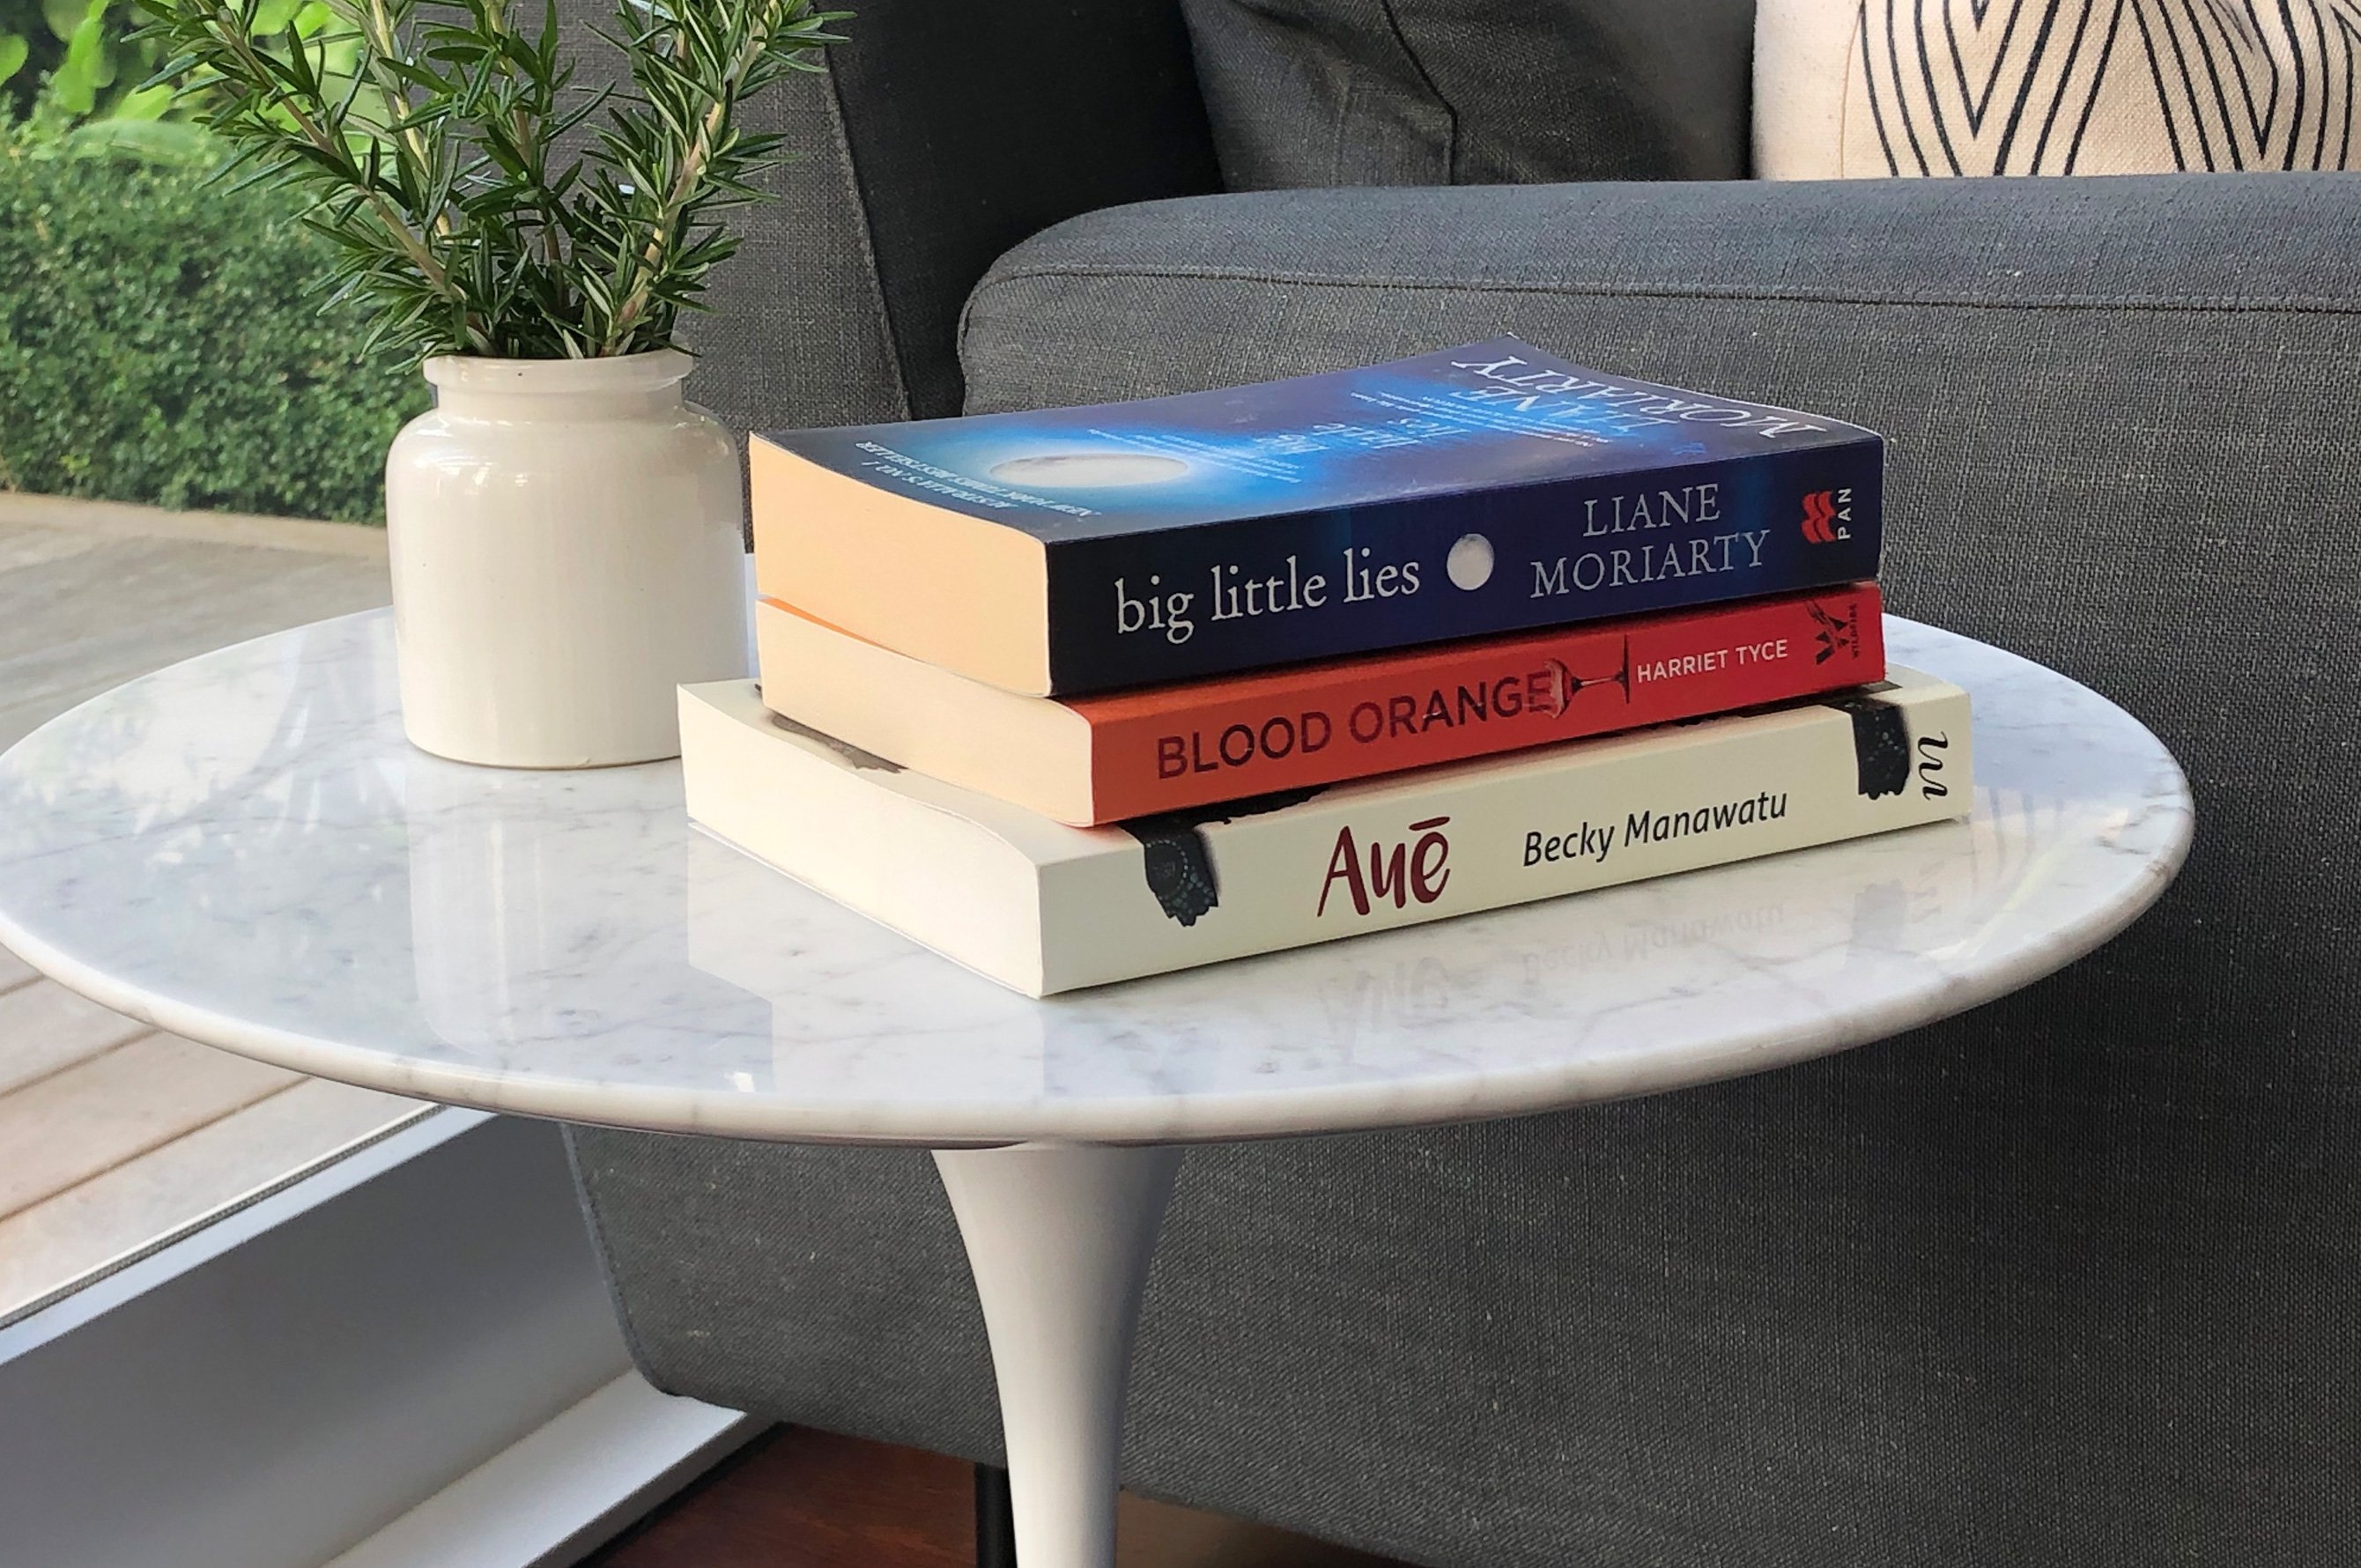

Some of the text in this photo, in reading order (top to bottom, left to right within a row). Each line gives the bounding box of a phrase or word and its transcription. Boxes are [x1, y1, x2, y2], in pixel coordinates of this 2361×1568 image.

[1450, 355, 1828, 439] MORIARTY
[1583, 483, 1721, 537] LIANE
[1838, 487, 1852, 540] PAN
[1114, 547, 1420, 645] big little lies
[1529, 529, 1771, 599] MORIARTY
[1637, 639, 1788, 683] HARRIET TYCE
[1158, 670, 1556, 780] BLOOD ORANGE
[1316, 816, 1451, 918] Auē
[1522, 791, 1787, 867] Becky Manawatu
